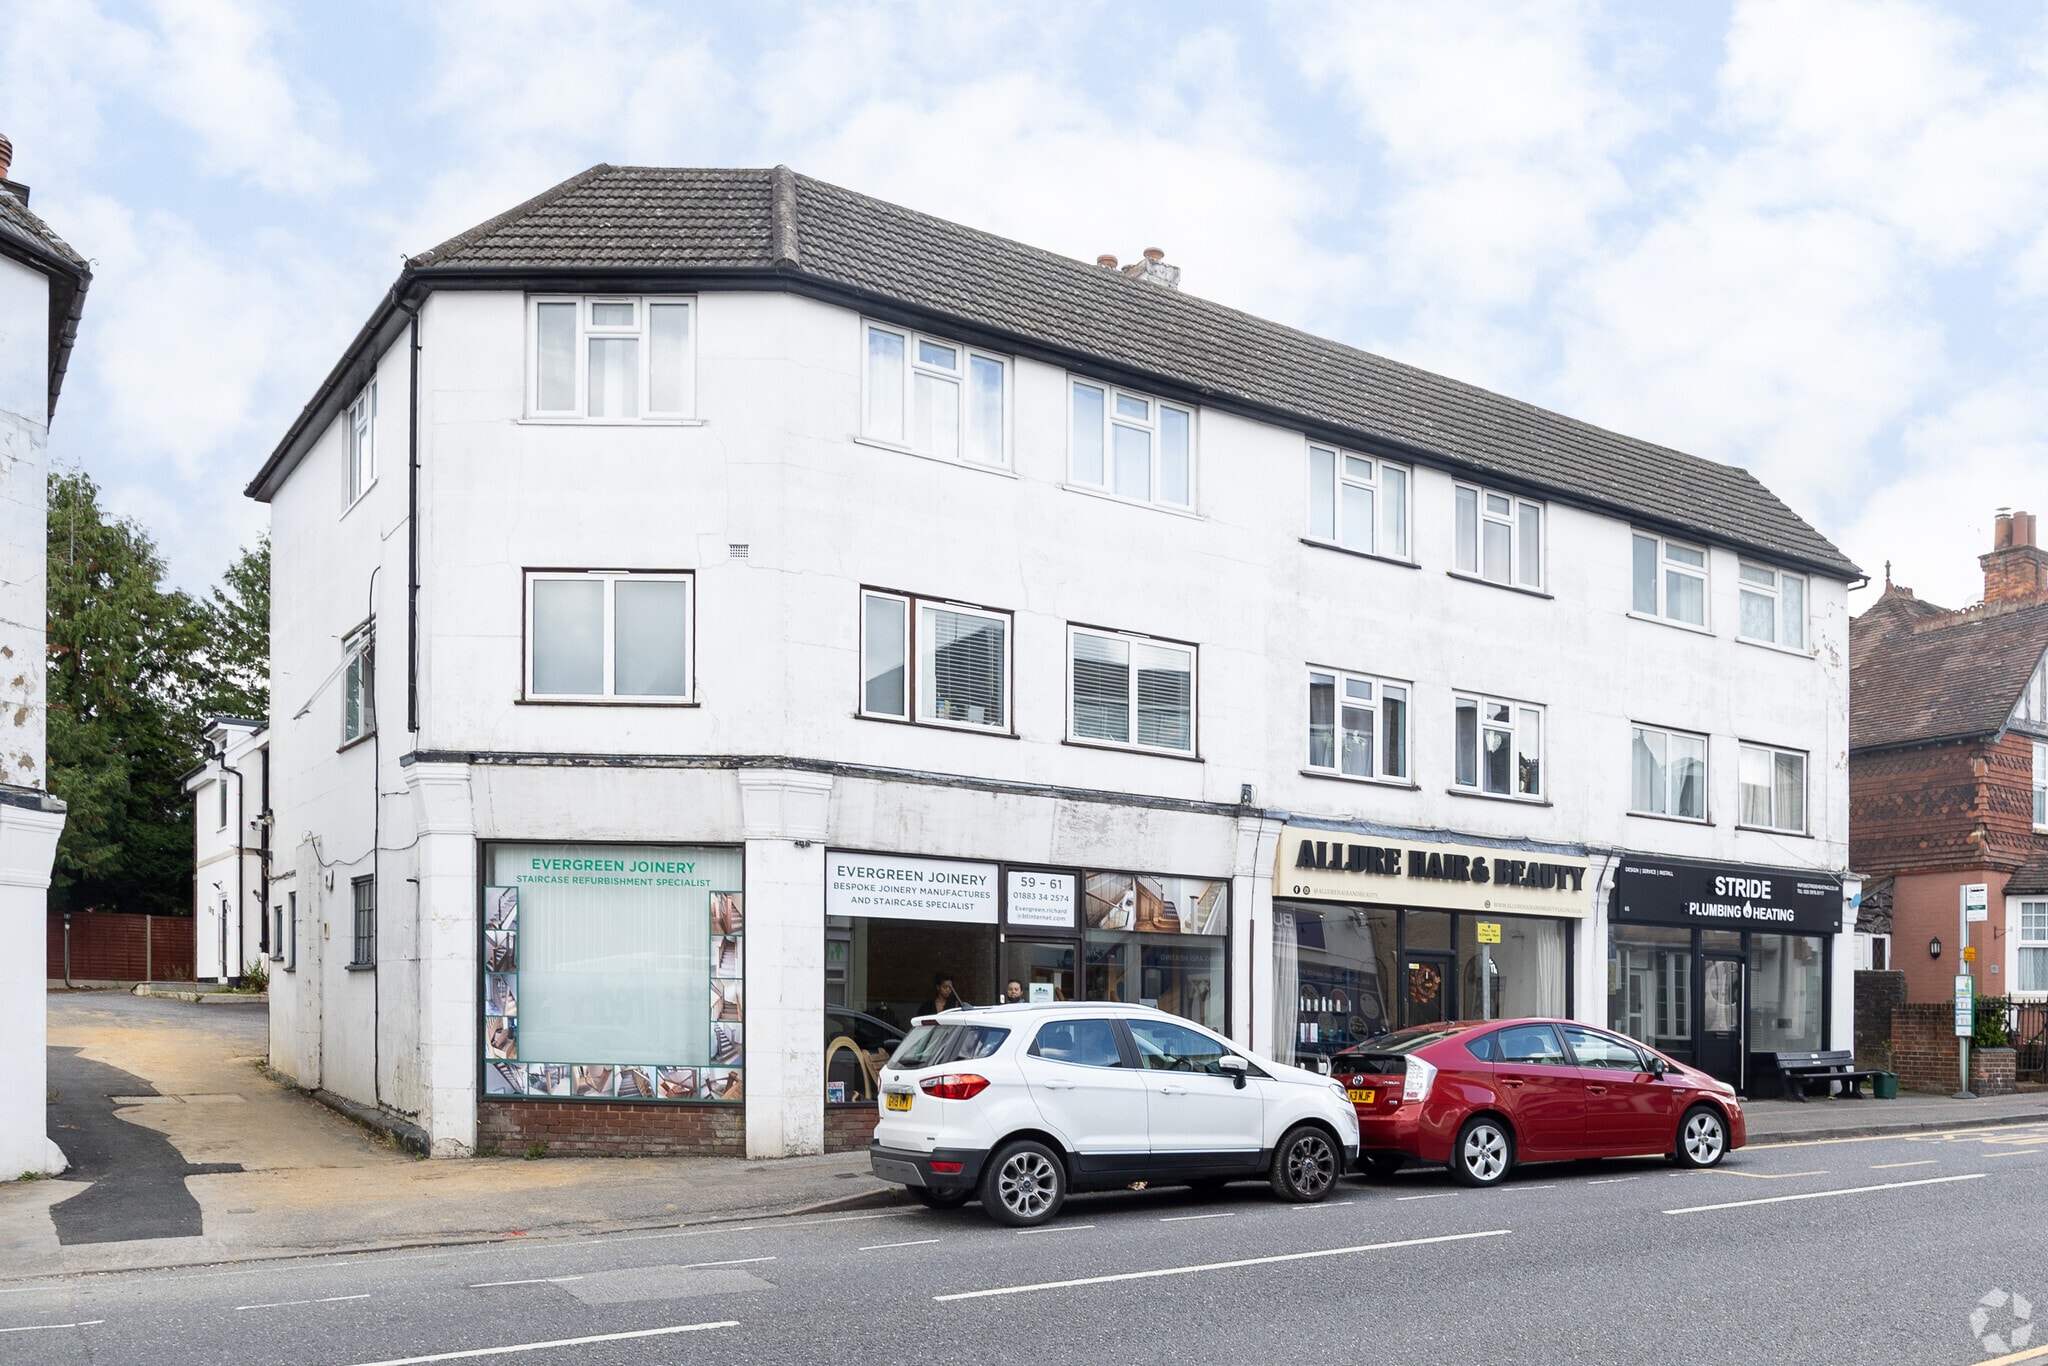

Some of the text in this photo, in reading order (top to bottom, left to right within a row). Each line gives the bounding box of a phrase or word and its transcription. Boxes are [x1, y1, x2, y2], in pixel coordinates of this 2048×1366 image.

[532, 858, 696, 874] EVERGREEN JOINERY
[1296, 840, 1401, 875] ALLURE
[1494, 858, 1586, 890] BEAUTY
[516, 875, 711, 887] STAIRCASE REFURBISHMENT SPECIALIST
[837, 866, 987, 886] EVERGREEN JOINERY
[1020, 877, 1036, 887] 59
[1050, 879, 1062, 889] 61
[834, 882, 990, 898] BESPOKE JOINERY MANUFACTURES
[1715, 876, 1771, 899] STRIDE
[851, 896, 974, 910] AND STAIRCASE SPECIALIST
[1689, 902, 1794, 921] PLUMBING HEATING
